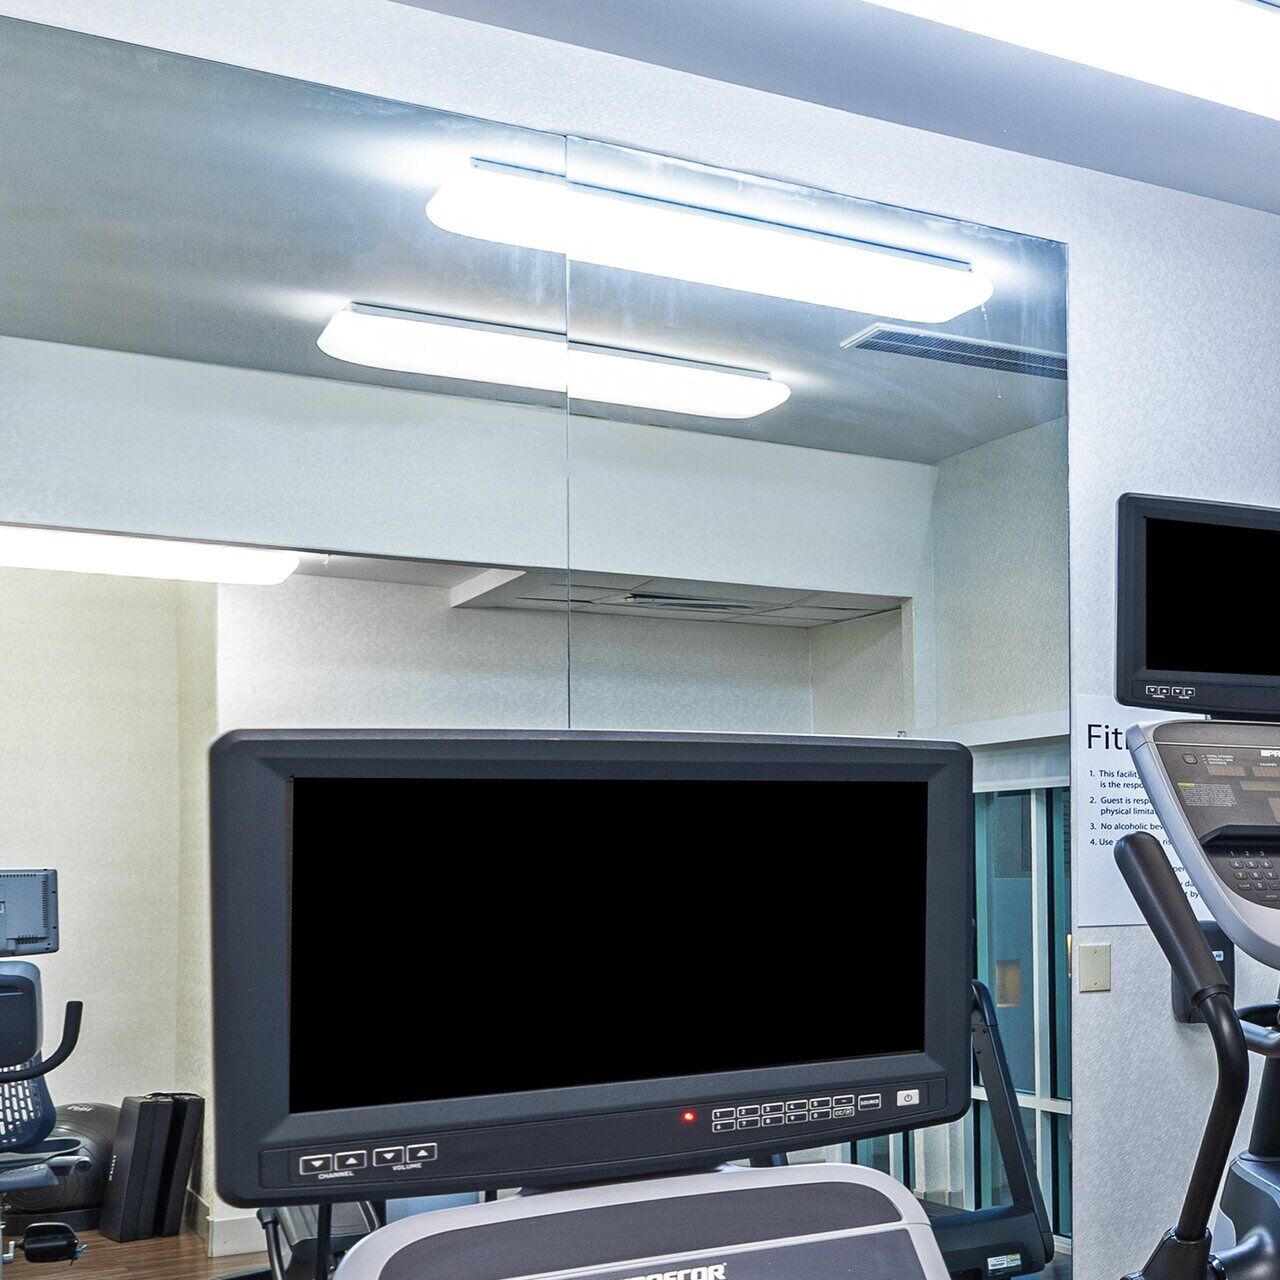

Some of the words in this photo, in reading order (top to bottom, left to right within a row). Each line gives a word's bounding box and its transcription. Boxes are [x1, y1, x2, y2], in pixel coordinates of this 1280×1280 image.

[1087, 723, 1130, 750] Fit
[1089, 769, 1096, 778] 1.
[1099, 769, 1115, 778] This
[1100, 781, 1107, 789] is
[1108, 781, 1121, 789] the
[1089, 796, 1097, 805] 2.
[1100, 796, 1123, 805] Guest
[1125, 797, 1132, 805] is
[1100, 808, 1132, 817] physical
[1133, 808, 1157, 816] limita
[1090, 822, 1097, 831] 3.
[1100, 822, 1112, 831] No
[1114, 822, 1148, 831] alcoholic
[1089, 838, 1097, 847] 4.
[1099, 838, 1114, 847] Use
[391, 1162, 422, 1171] VOLUME
[318, 1170, 355, 1180] CHANNEL
